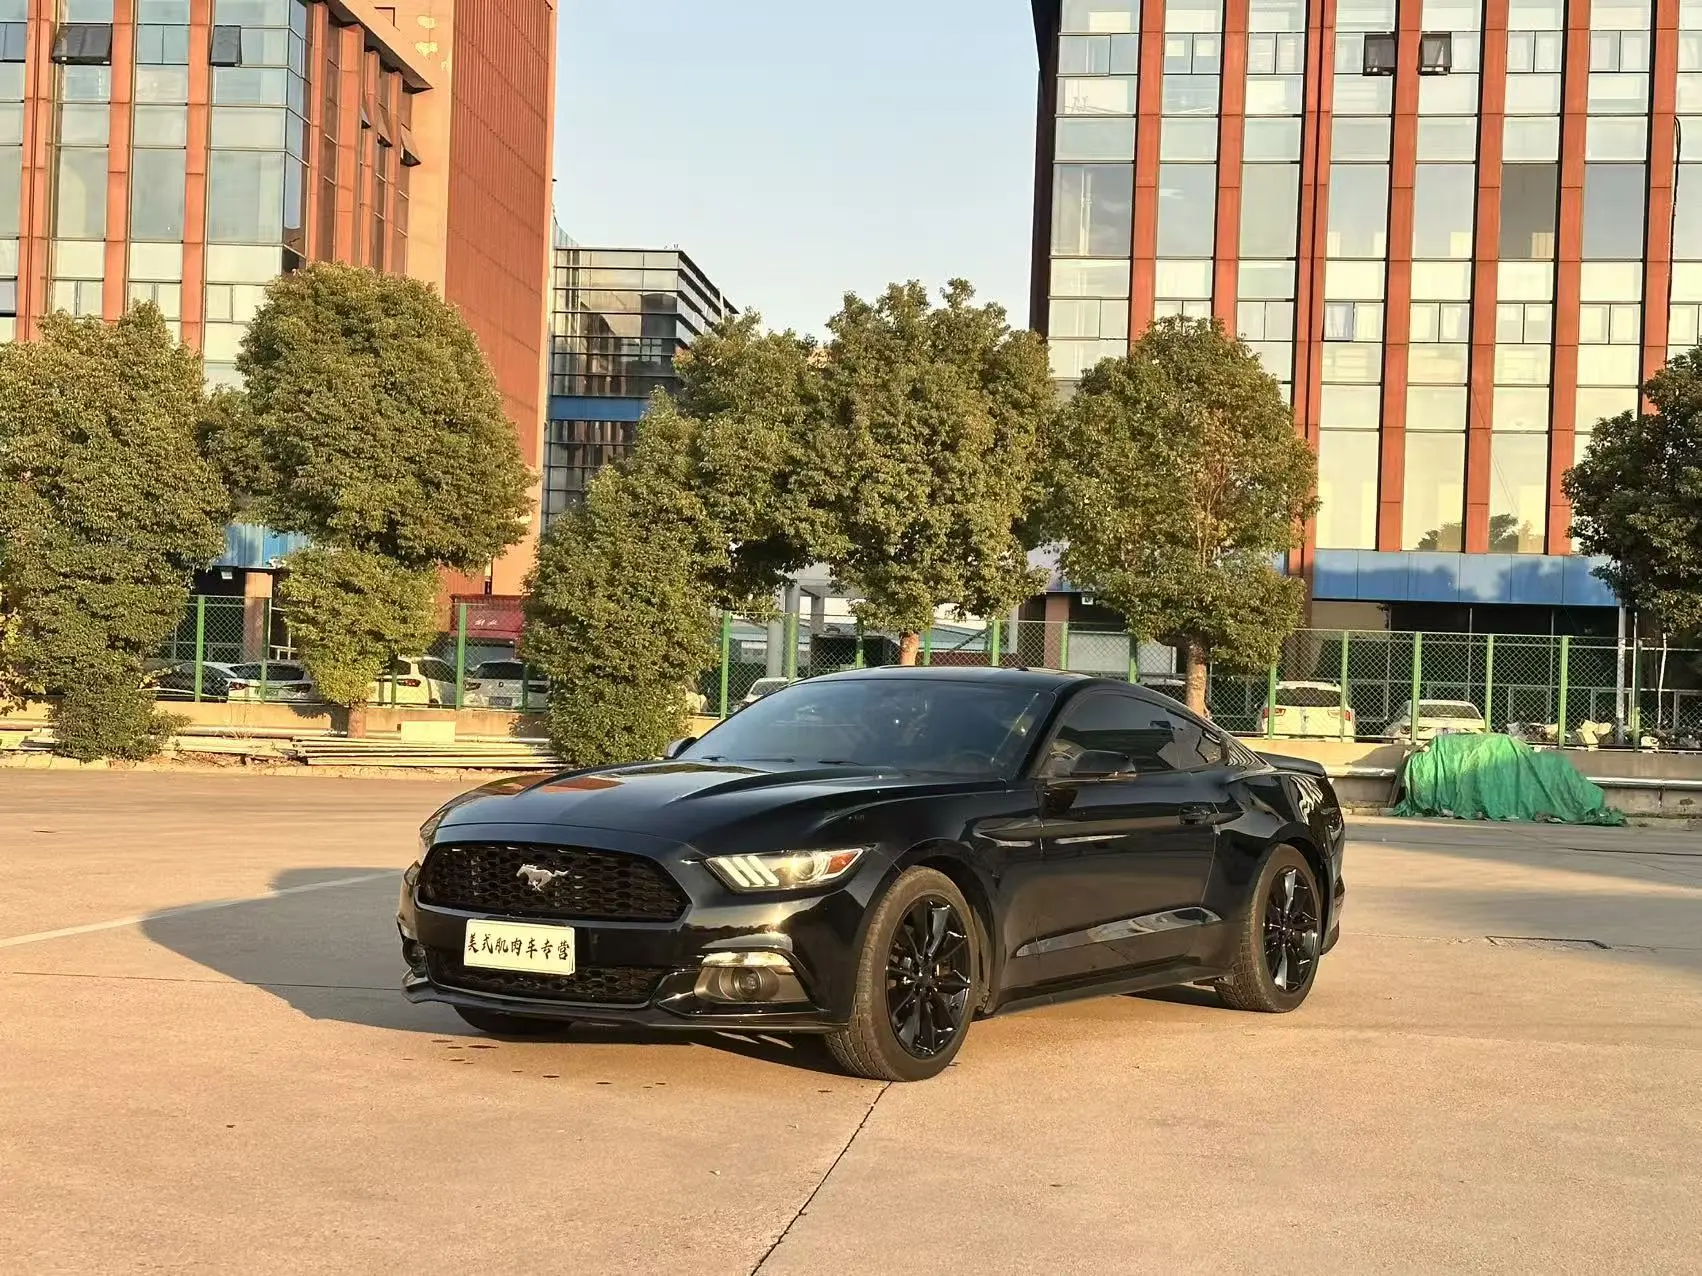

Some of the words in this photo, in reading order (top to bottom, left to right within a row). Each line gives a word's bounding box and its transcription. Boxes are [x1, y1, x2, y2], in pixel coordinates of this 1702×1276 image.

[467, 932, 570, 961] 美式肌肉车专营
